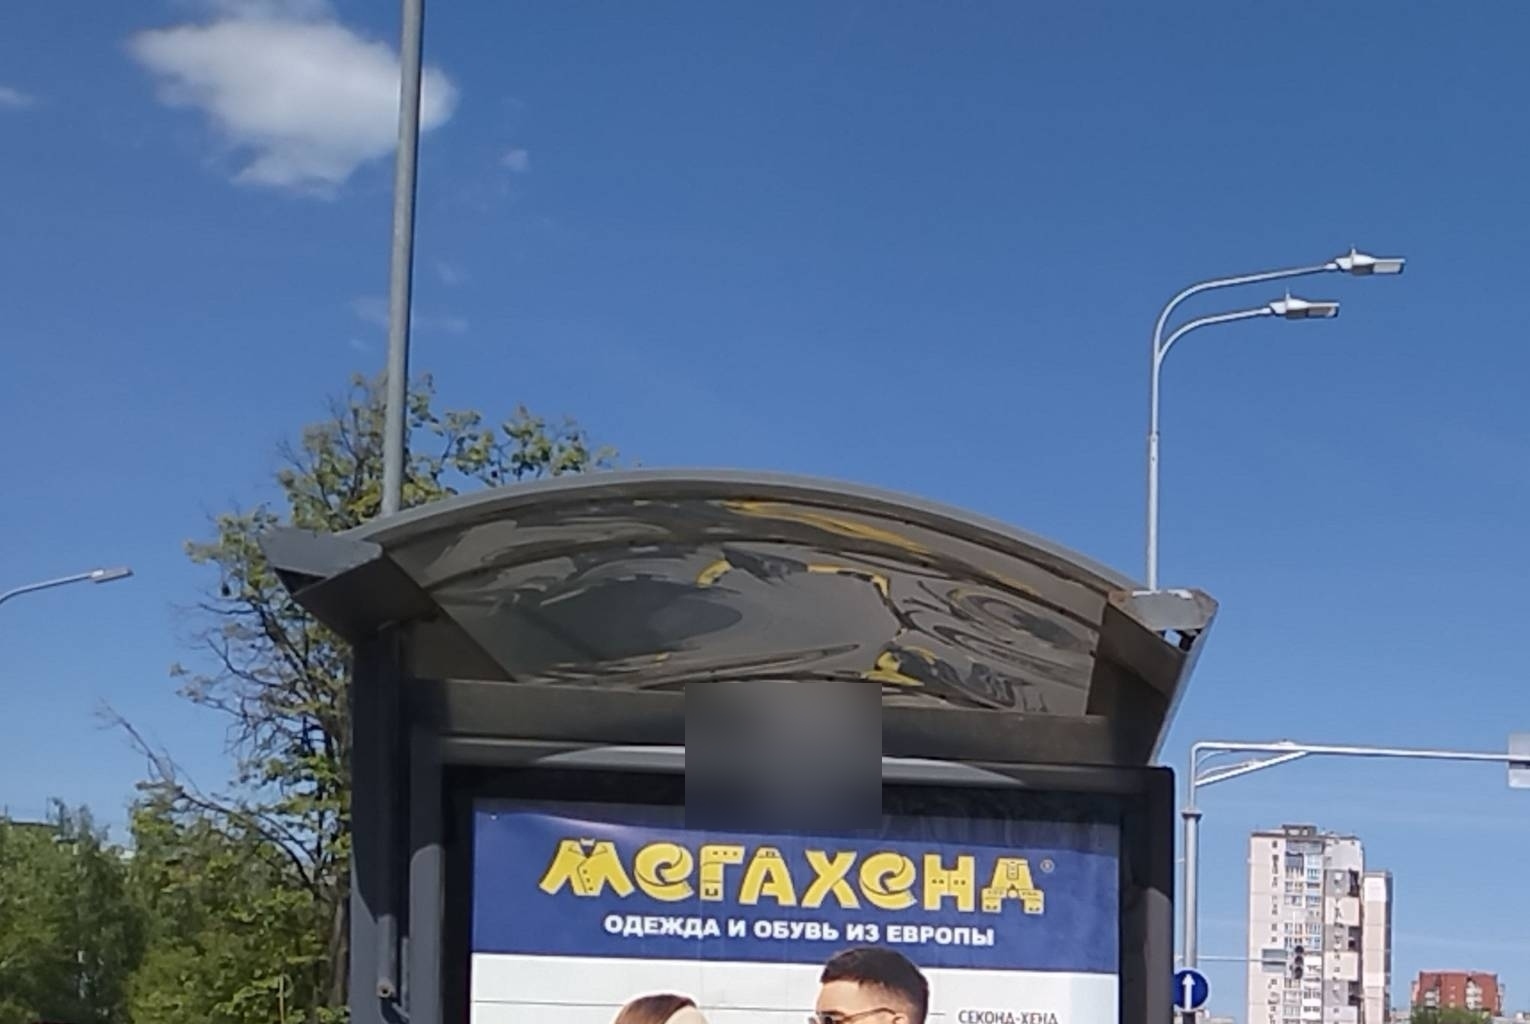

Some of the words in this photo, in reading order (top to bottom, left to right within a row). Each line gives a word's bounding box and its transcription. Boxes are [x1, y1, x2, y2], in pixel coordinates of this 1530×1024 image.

[604, 914, 720, 939] ОДЕЖДА
[728, 919, 745, 938] И
[753, 919, 839, 942] ОБУВЬ
[846, 922, 880, 943] ИЗ
[886, 924, 994, 947] ЕВРОПЫ
